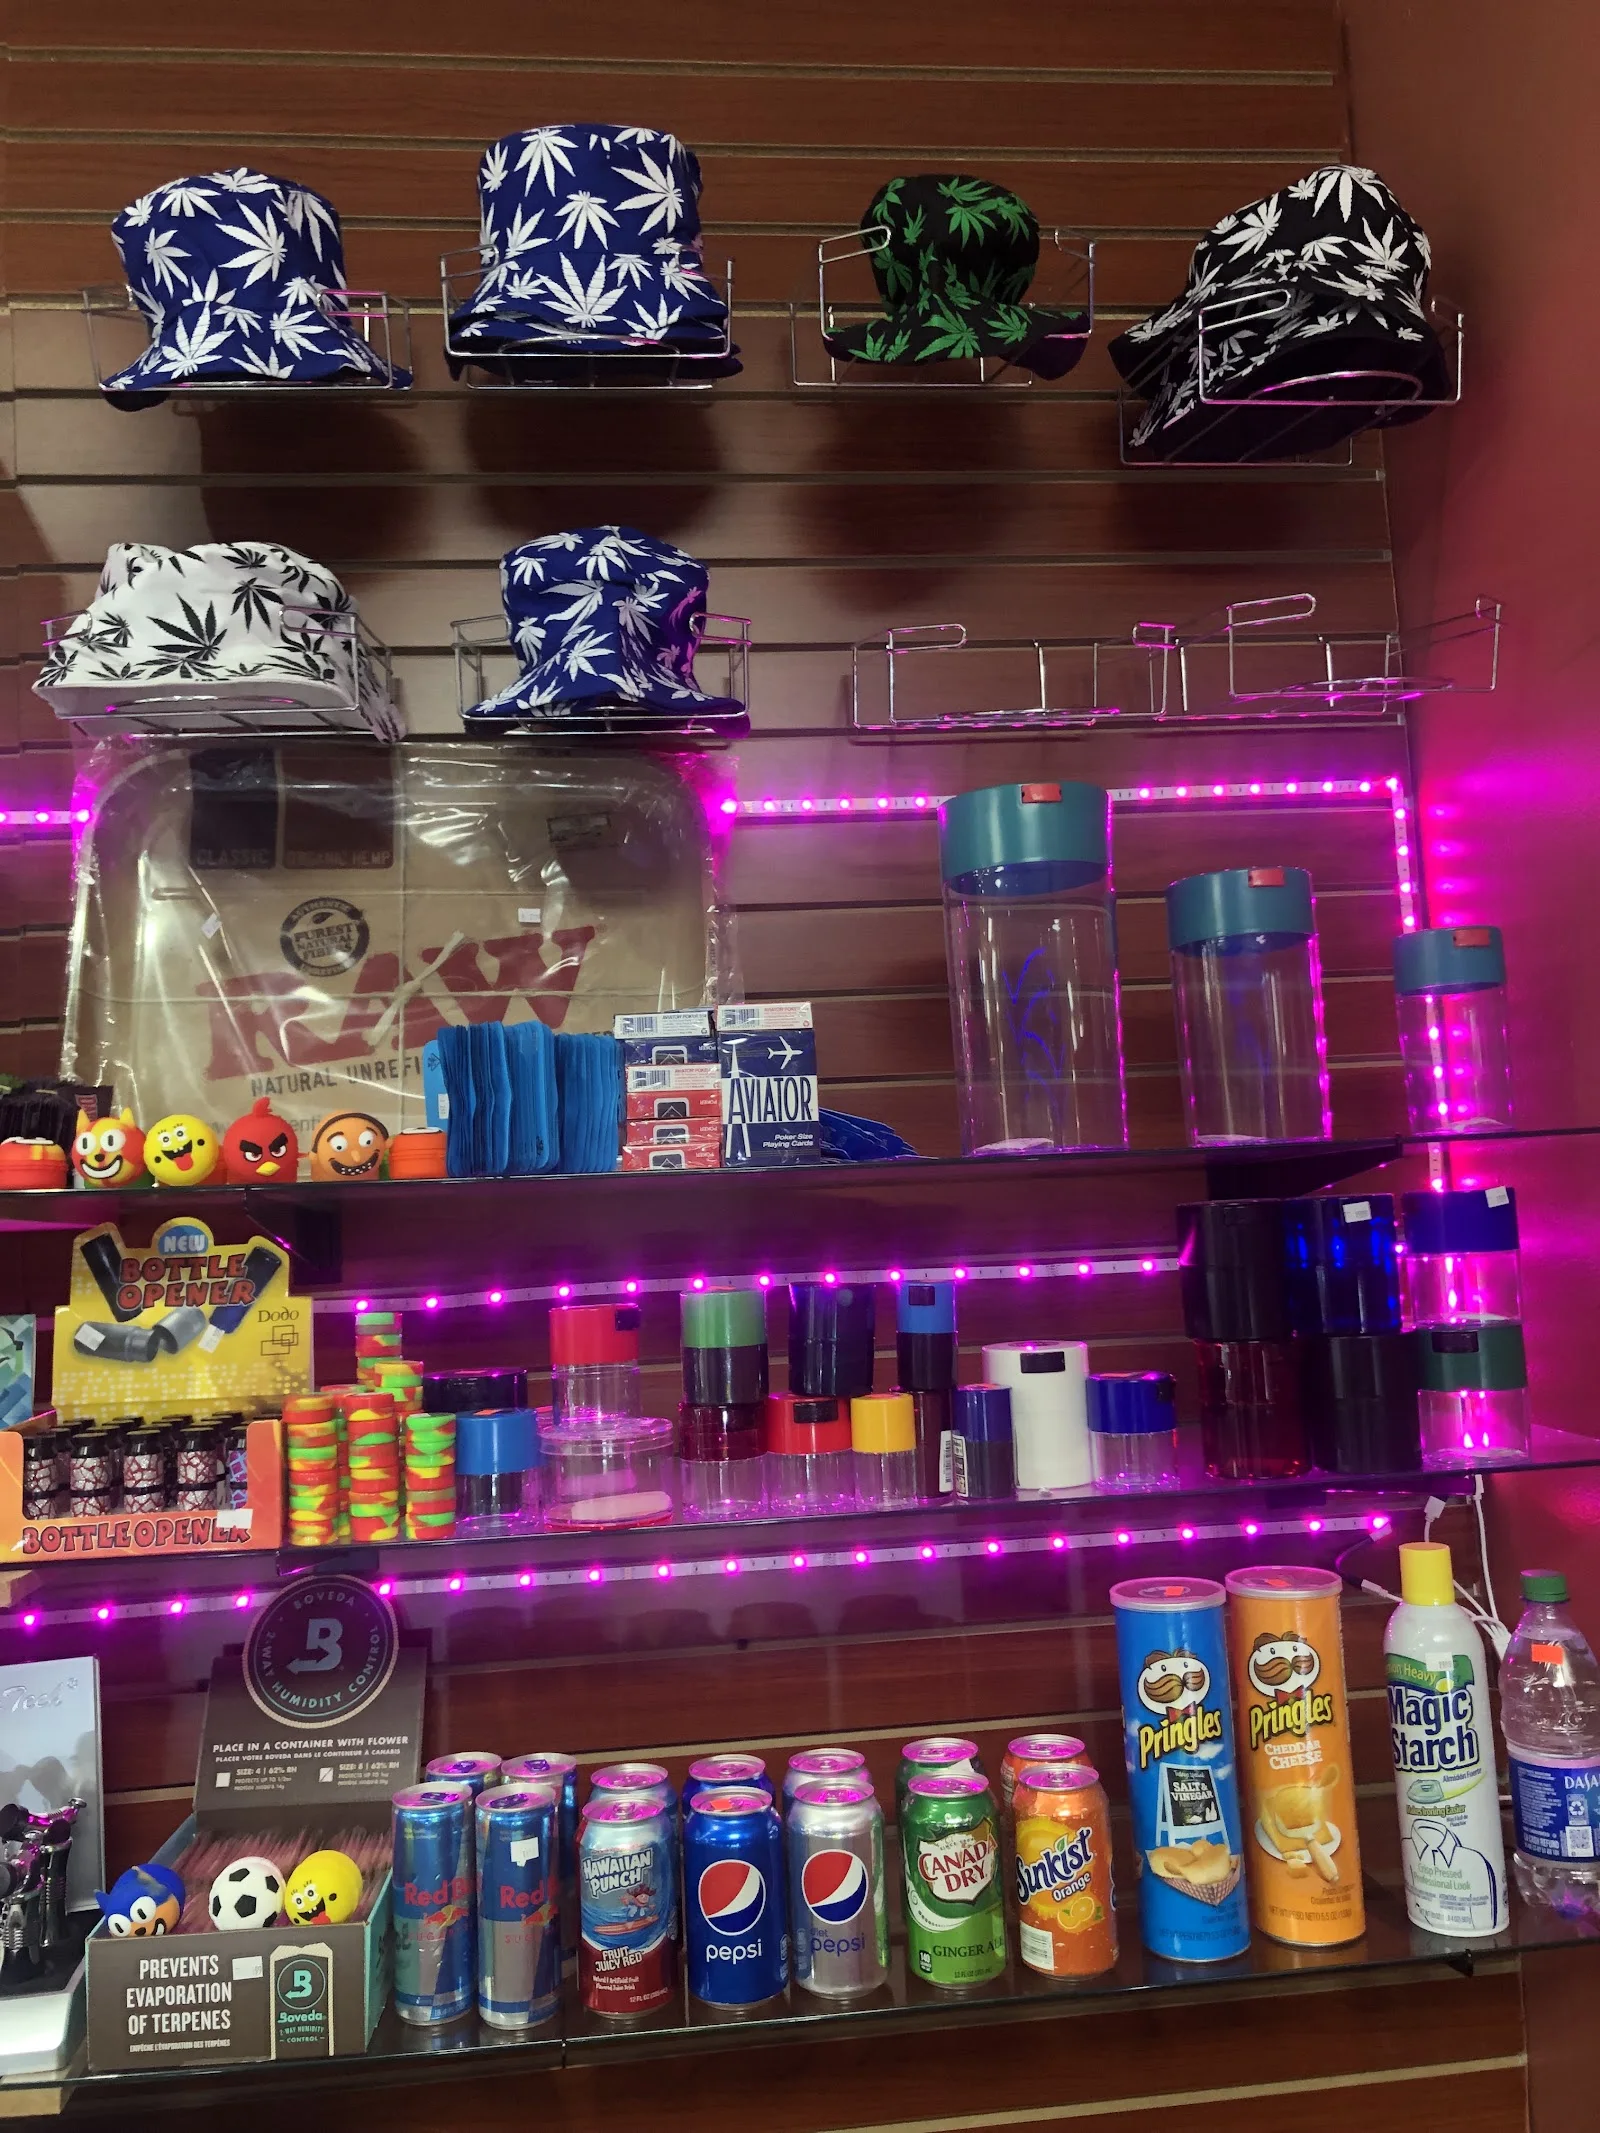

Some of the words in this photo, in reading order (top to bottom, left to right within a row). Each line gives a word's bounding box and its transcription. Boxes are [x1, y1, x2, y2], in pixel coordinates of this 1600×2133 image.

[352, 850, 393, 866] HEMP
[195, 925, 596, 1081] RAW
[251, 1070, 338, 1097] NATURAL
[348, 1058, 421, 1085] UNREFI
[728, 1076, 813, 1125] AVIATOR
[762, 1141, 790, 1149] Playing
[774, 1133, 796, 1141] Poker
[163, 1235, 206, 1253] NEW
[120, 1253, 247, 1284] BOTTLE
[116, 1278, 256, 1311] OPENER
[257, 1306, 300, 1323] Dodo
[22, 1521, 132, 1555] BOTTLE
[293, 1590, 355, 1609] BOVEDA
[271, 1681, 343, 1709] HUMIDITY
[348, 1625, 381, 1693] CONTROL
[1403, 1663, 1437, 1686] Heavy
[1249, 1688, 1333, 1750] Pringles
[1388, 1687, 1469, 1736] Magic
[212, 1743, 244, 1753] PLACE
[247, 1742, 260, 1751] IN
[263, 1742, 271, 1751] A
[274, 1739, 334, 1750] CONTAINER
[337, 1737, 365, 1747] WITH
[367, 1736, 409, 1746] FLOWER
[1138, 1706, 1223, 1769] Pringles
[1264, 1740, 1321, 1755] CHEDDAR
[1392, 1725, 1475, 1767] Starch
[1269, 1750, 1323, 1770] CHEESE
[1172, 1781, 1201, 1792] SALT
[1564, 1772, 1600, 1791] DASA
[1170, 1790, 1214, 1801] VINEGAR
[582, 1849, 652, 1881] HAWAIIAN
[918, 1833, 998, 1882] CANADA
[1015, 1826, 1093, 1906] Sunkist
[590, 1867, 643, 1897] PUNCH
[944, 1864, 987, 1893] DRY
[1413, 1871, 1452, 1890] Professional
[1453, 1881, 1472, 1890] Look
[1417, 1863, 1434, 1878] Crisp
[1434, 1866, 1463, 1879] Pressed
[404, 1880, 448, 1906] Red
[500, 1880, 544, 1908] Red
[1052, 1871, 1092, 1903] Orange
[602, 1945, 630, 1960] FRUIT
[705, 1938, 763, 1965] pepsi
[811, 1932, 866, 1957] pepsi
[932, 1944, 984, 1958] GINGER
[985, 1935, 1004, 1952] ALE
[139, 1954, 219, 1980] PREVENTS
[595, 1959, 621, 1972] JUICY
[622, 1951, 643, 1967] RED
[126, 1981, 232, 2008] EVAPORATION
[127, 2014, 148, 2036] OF
[151, 2009, 231, 2033] TERPENES
[277, 2009, 323, 2024] Boveda
[286, 2035, 318, 2043] CONTROL
